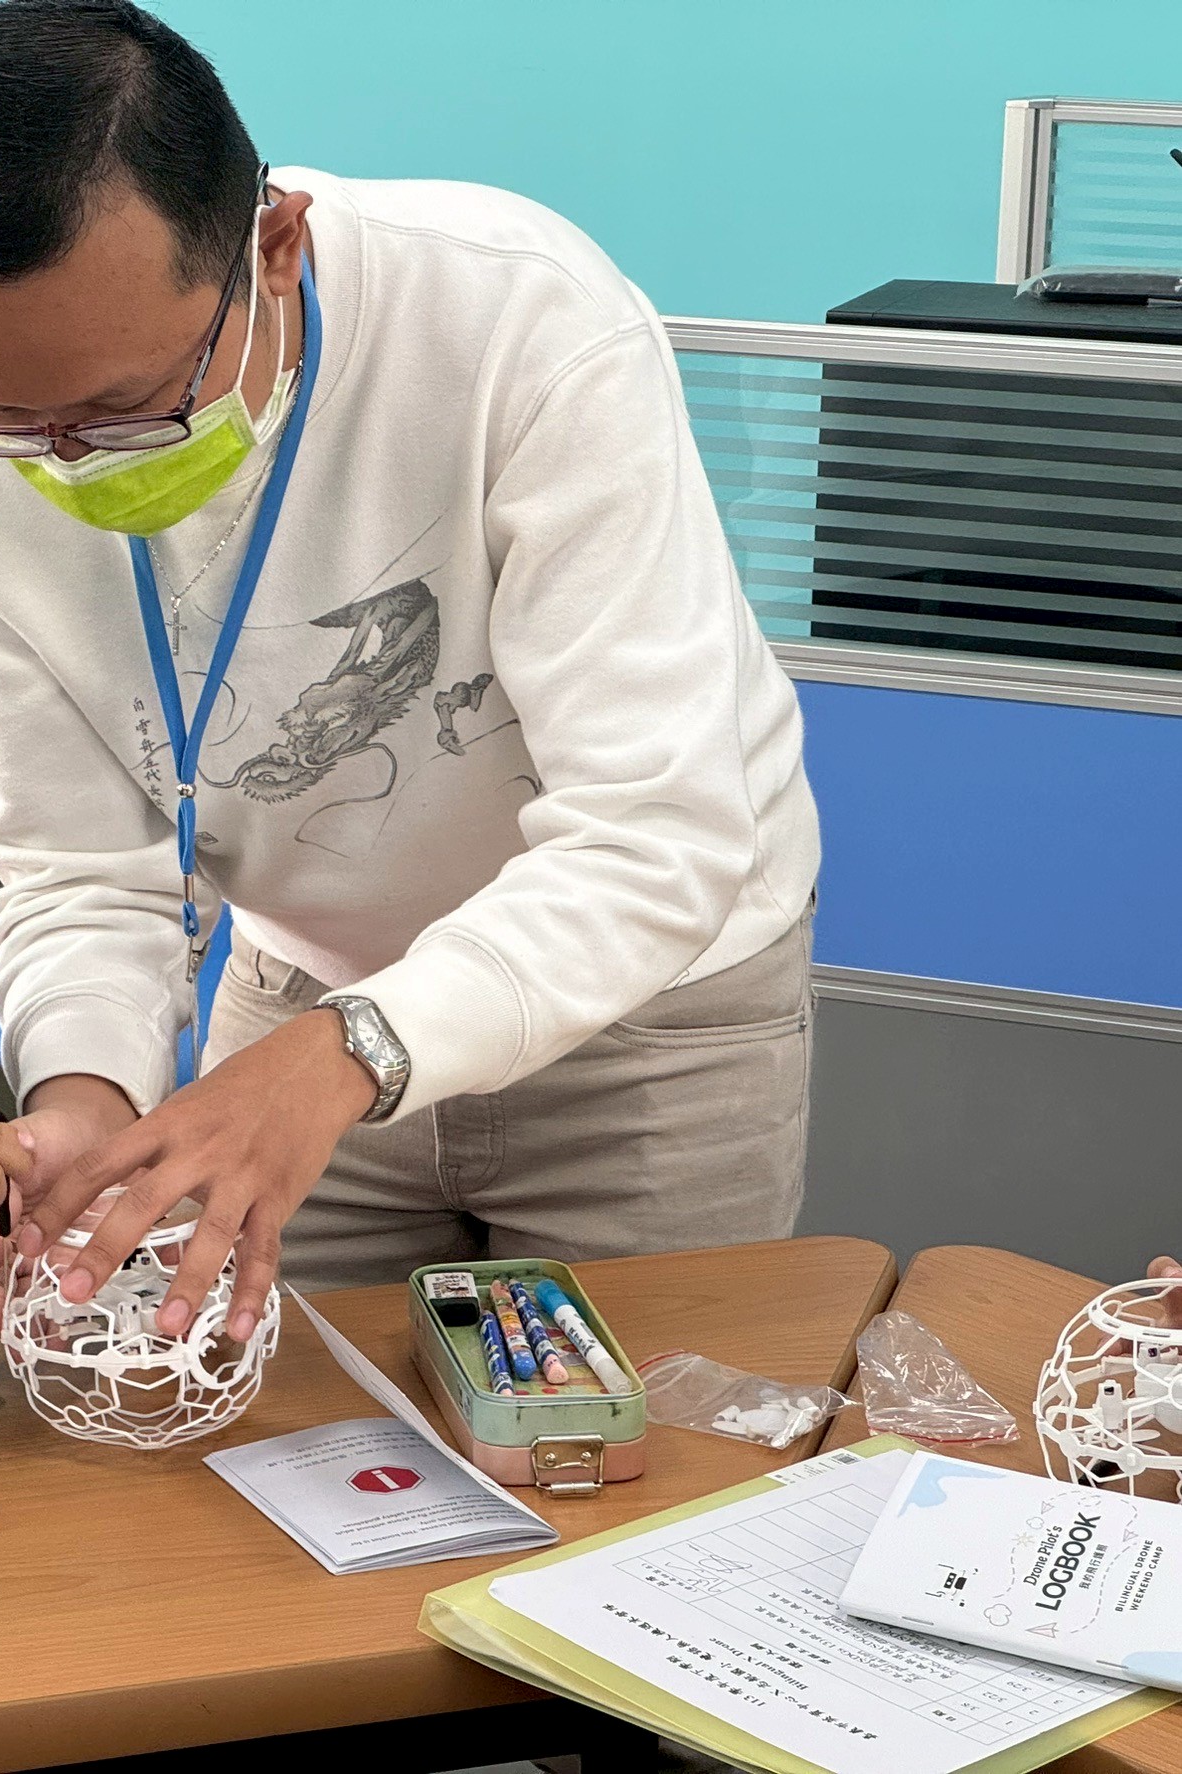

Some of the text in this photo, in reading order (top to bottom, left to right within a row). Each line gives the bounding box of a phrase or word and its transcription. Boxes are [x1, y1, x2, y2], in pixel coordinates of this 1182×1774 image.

[1023, 1525, 1062, 1586] Drone Pilot's
[1035, 1512, 1101, 1611] LOGBOOK
[1079, 1544, 1109, 1589] 我的飛行護照
[1115, 1540, 1154, 1612] BILINGUAL DRONE
[1130, 1546, 1164, 1611] WEEKEND CAMP
[708, 1637, 808, 1690] Bilingual X Drone
[770, 1687, 786, 1697] X
[742, 1694, 765, 1706] 113
